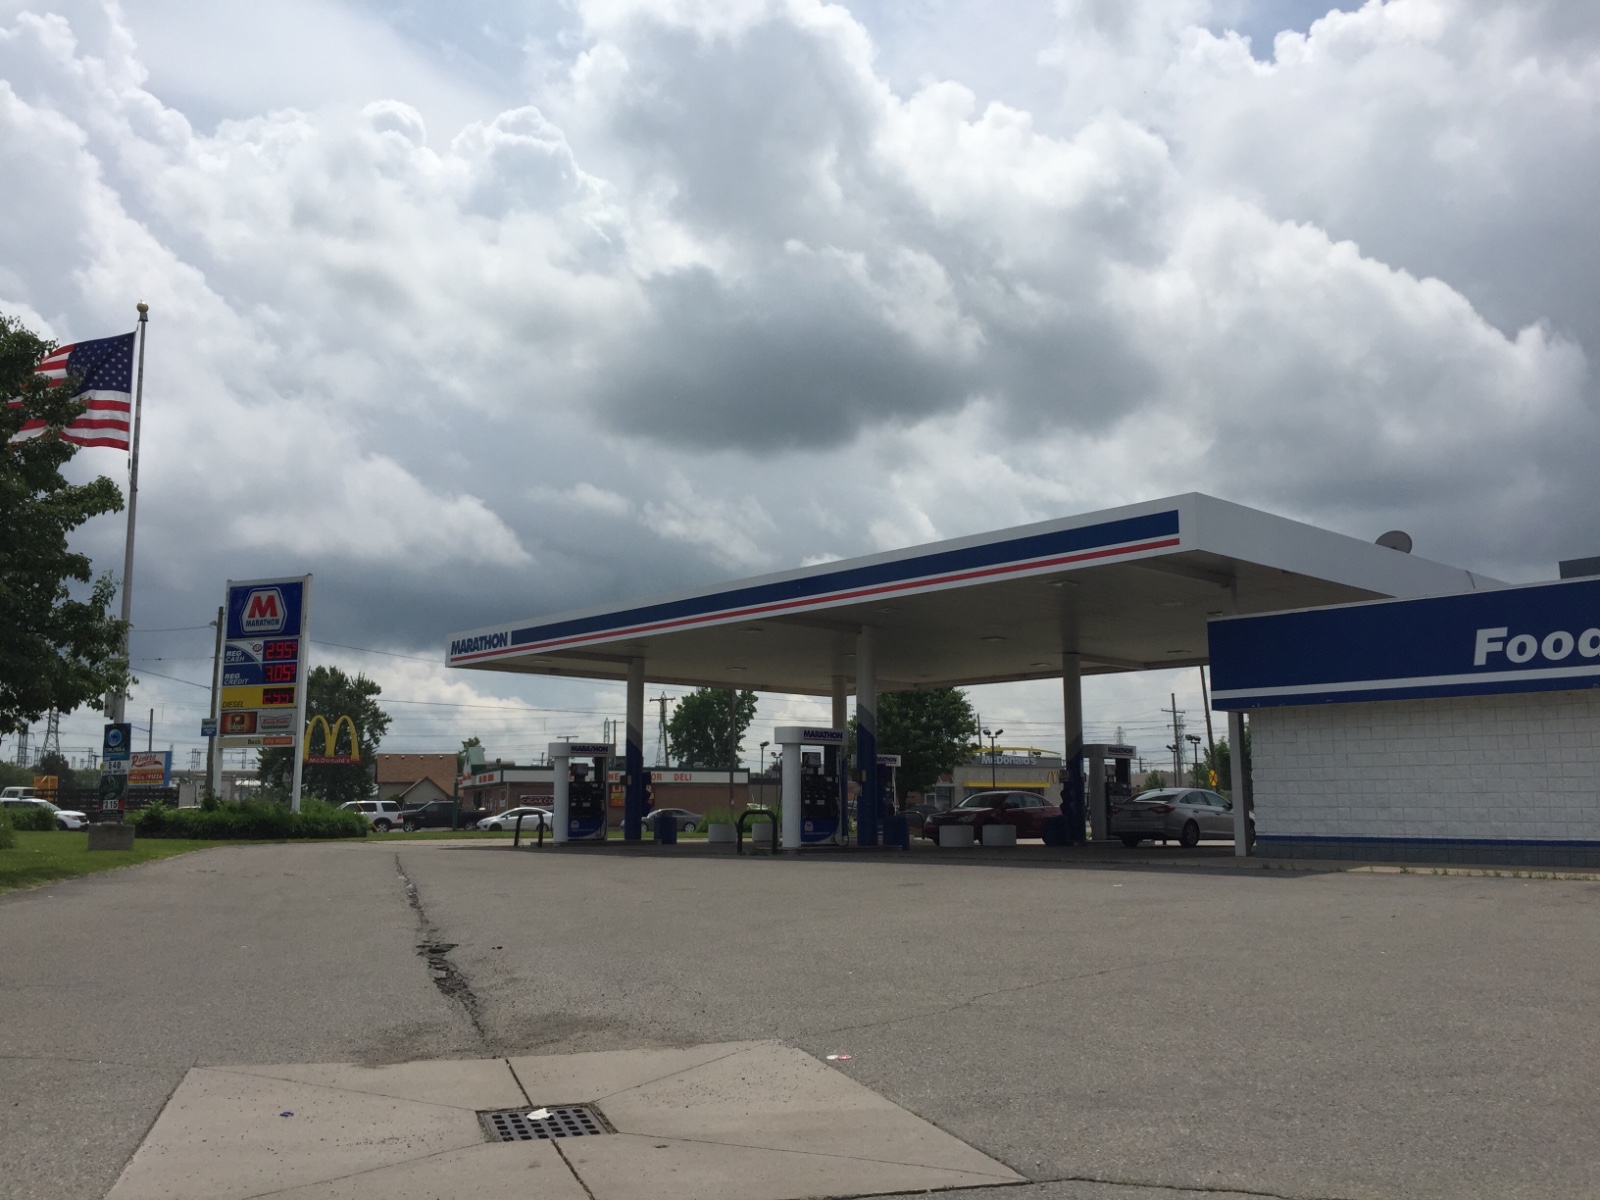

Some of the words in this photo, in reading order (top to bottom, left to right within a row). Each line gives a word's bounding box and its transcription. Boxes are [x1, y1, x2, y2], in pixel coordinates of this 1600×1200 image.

[248, 595, 278, 618] M
[246, 618, 280, 627] MARATHON
[451, 632, 508, 655] MARATHON
[224, 672, 240, 680] REG
[224, 678, 249, 686] CREDIT
[803, 730, 843, 740] MARATHON
[571, 745, 609, 753] MARATHON
[981, 755, 1037, 765] McDonald's
[673, 773, 692, 781] DELI
[104, 800, 118, 809] 315
